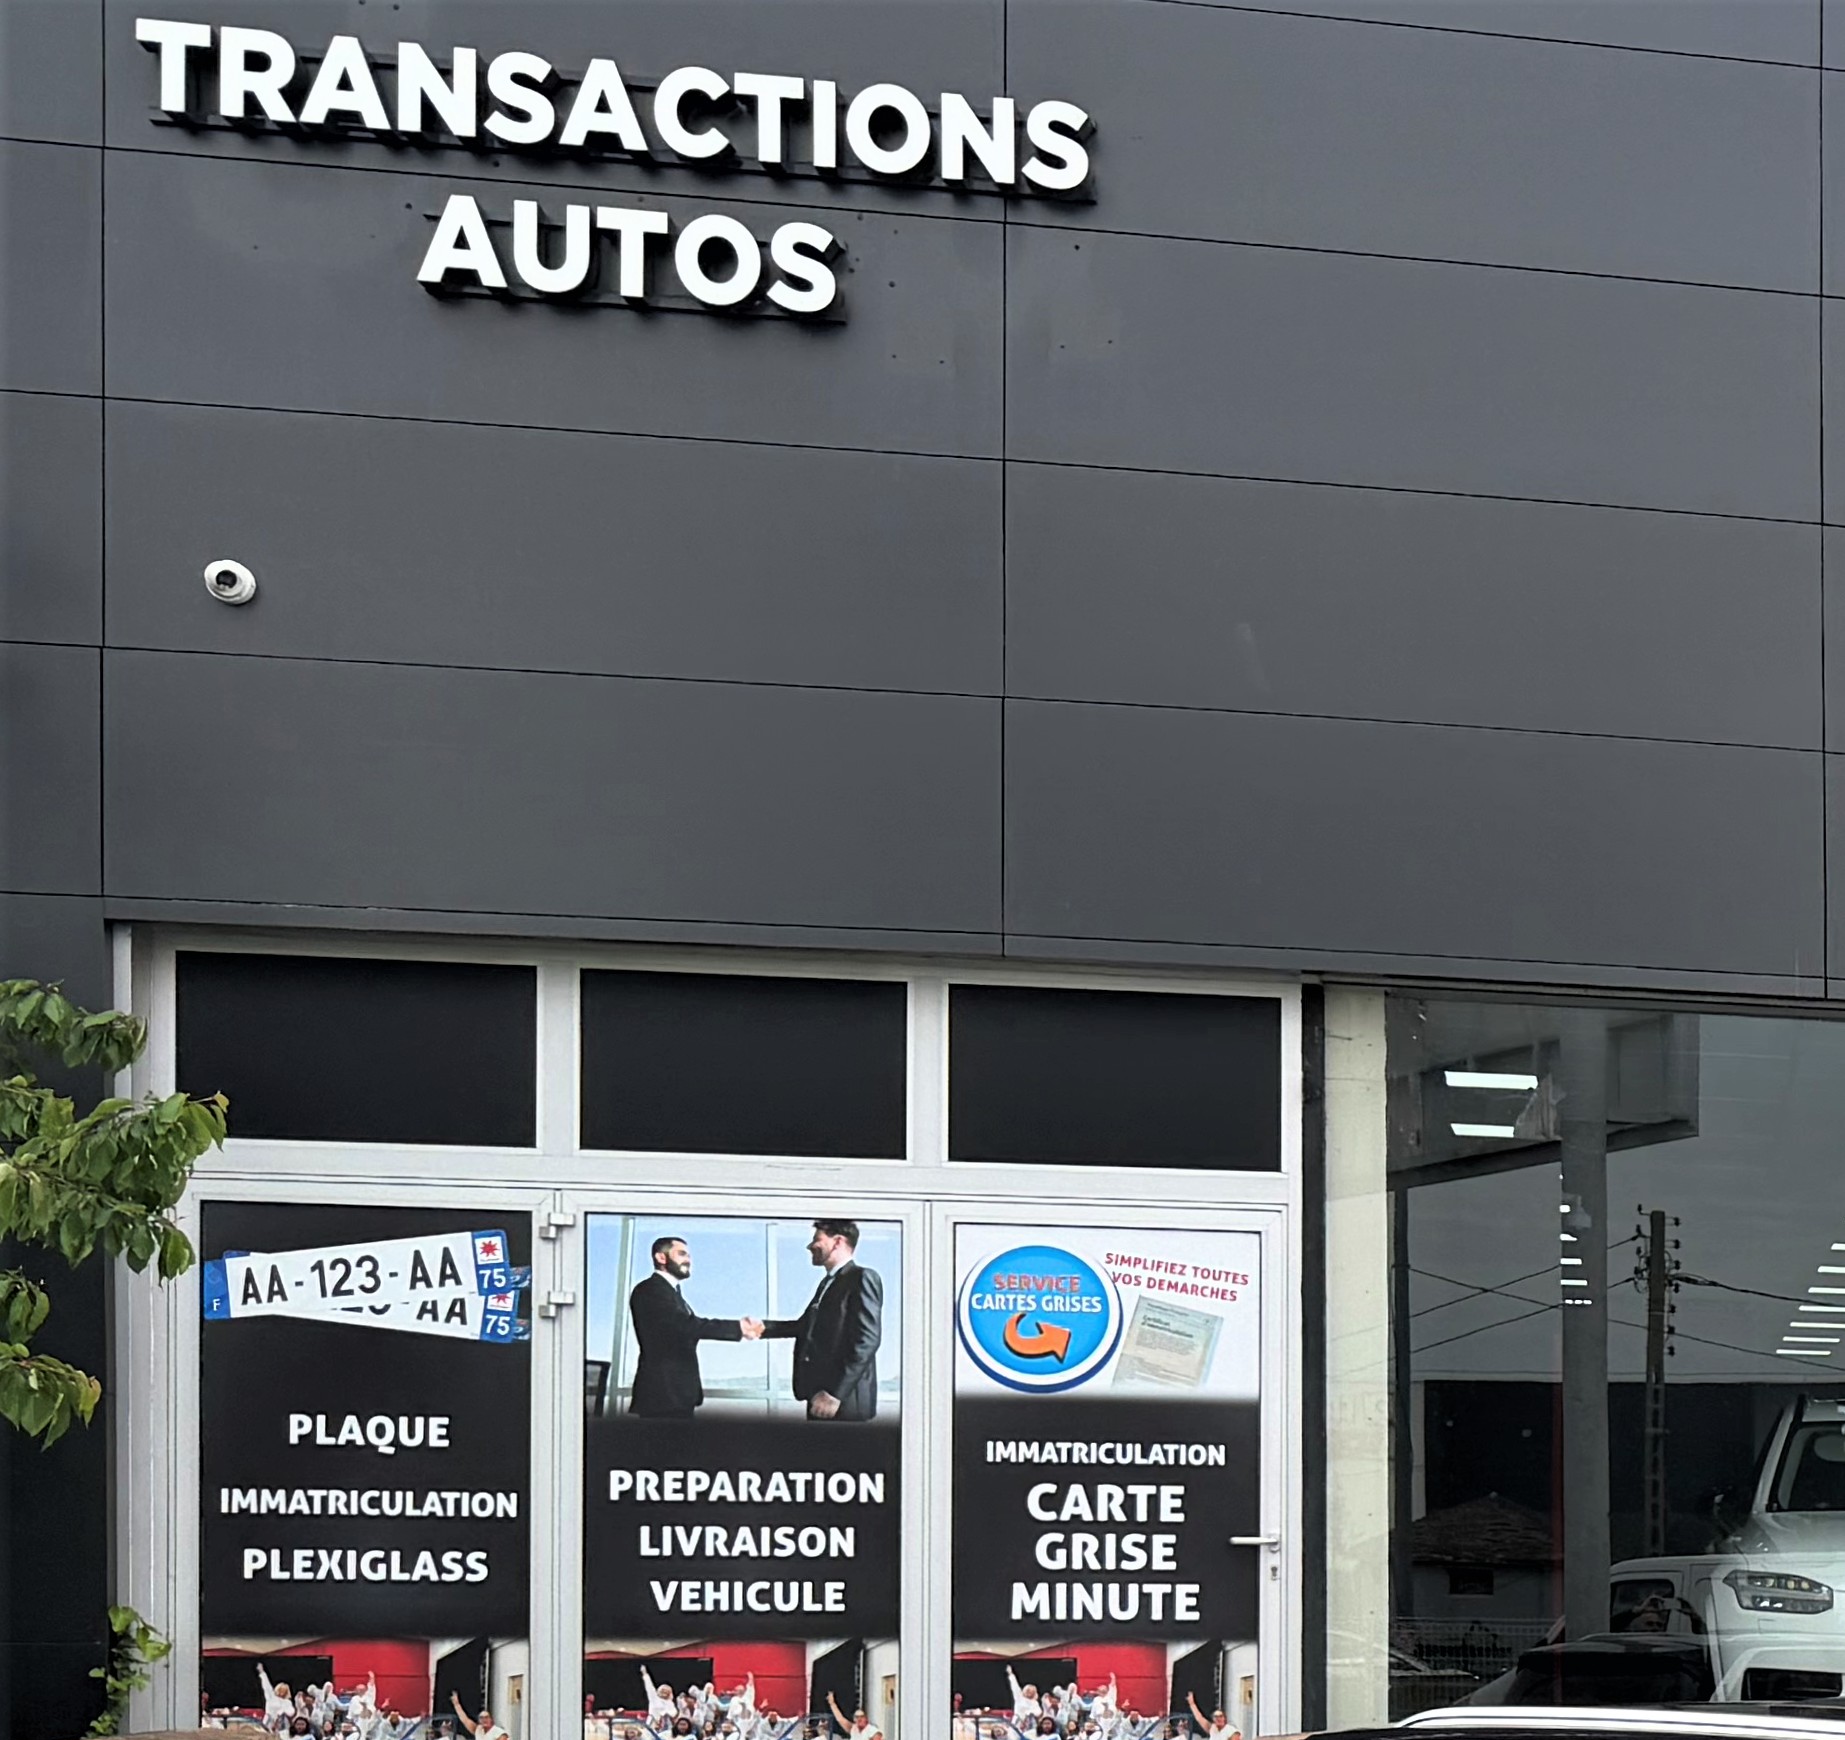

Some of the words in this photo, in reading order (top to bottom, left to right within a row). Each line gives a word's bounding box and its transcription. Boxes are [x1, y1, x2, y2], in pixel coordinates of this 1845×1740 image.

[136, 17, 1092, 192] TRANSACTIONS
[416, 194, 837, 314] AUTOS
[479, 1267, 506, 1289] 75
[993, 1273, 1082, 1293] SERVICE
[1105, 1252, 1187, 1277] SIMPLIFIEZ
[1192, 1265, 1249, 1286] TOUTES
[971, 1293, 1037, 1312] CARTES
[1041, 1295, 1102, 1313] GRISES
[1112, 1271, 1142, 1287] VOS
[1146, 1276, 1238, 1302] DEMARCHES
[212, 1298, 221, 1312] F
[486, 1314, 511, 1336] 75
[289, 1413, 451, 1454] PLAQUE
[986, 1440, 1227, 1467] IMMATRICULATION
[608, 1469, 885, 1503] PREPARATION
[219, 1487, 519, 1519] IMMATRICULATION
[1026, 1482, 1186, 1524] CARTE
[638, 1526, 857, 1559] LIVRAISON
[1034, 1532, 1178, 1571] GRISE
[242, 1548, 490, 1582] PLEXIGLASS
[649, 1580, 847, 1613] VEHICULE
[1009, 1581, 1201, 1622] MINUTE
